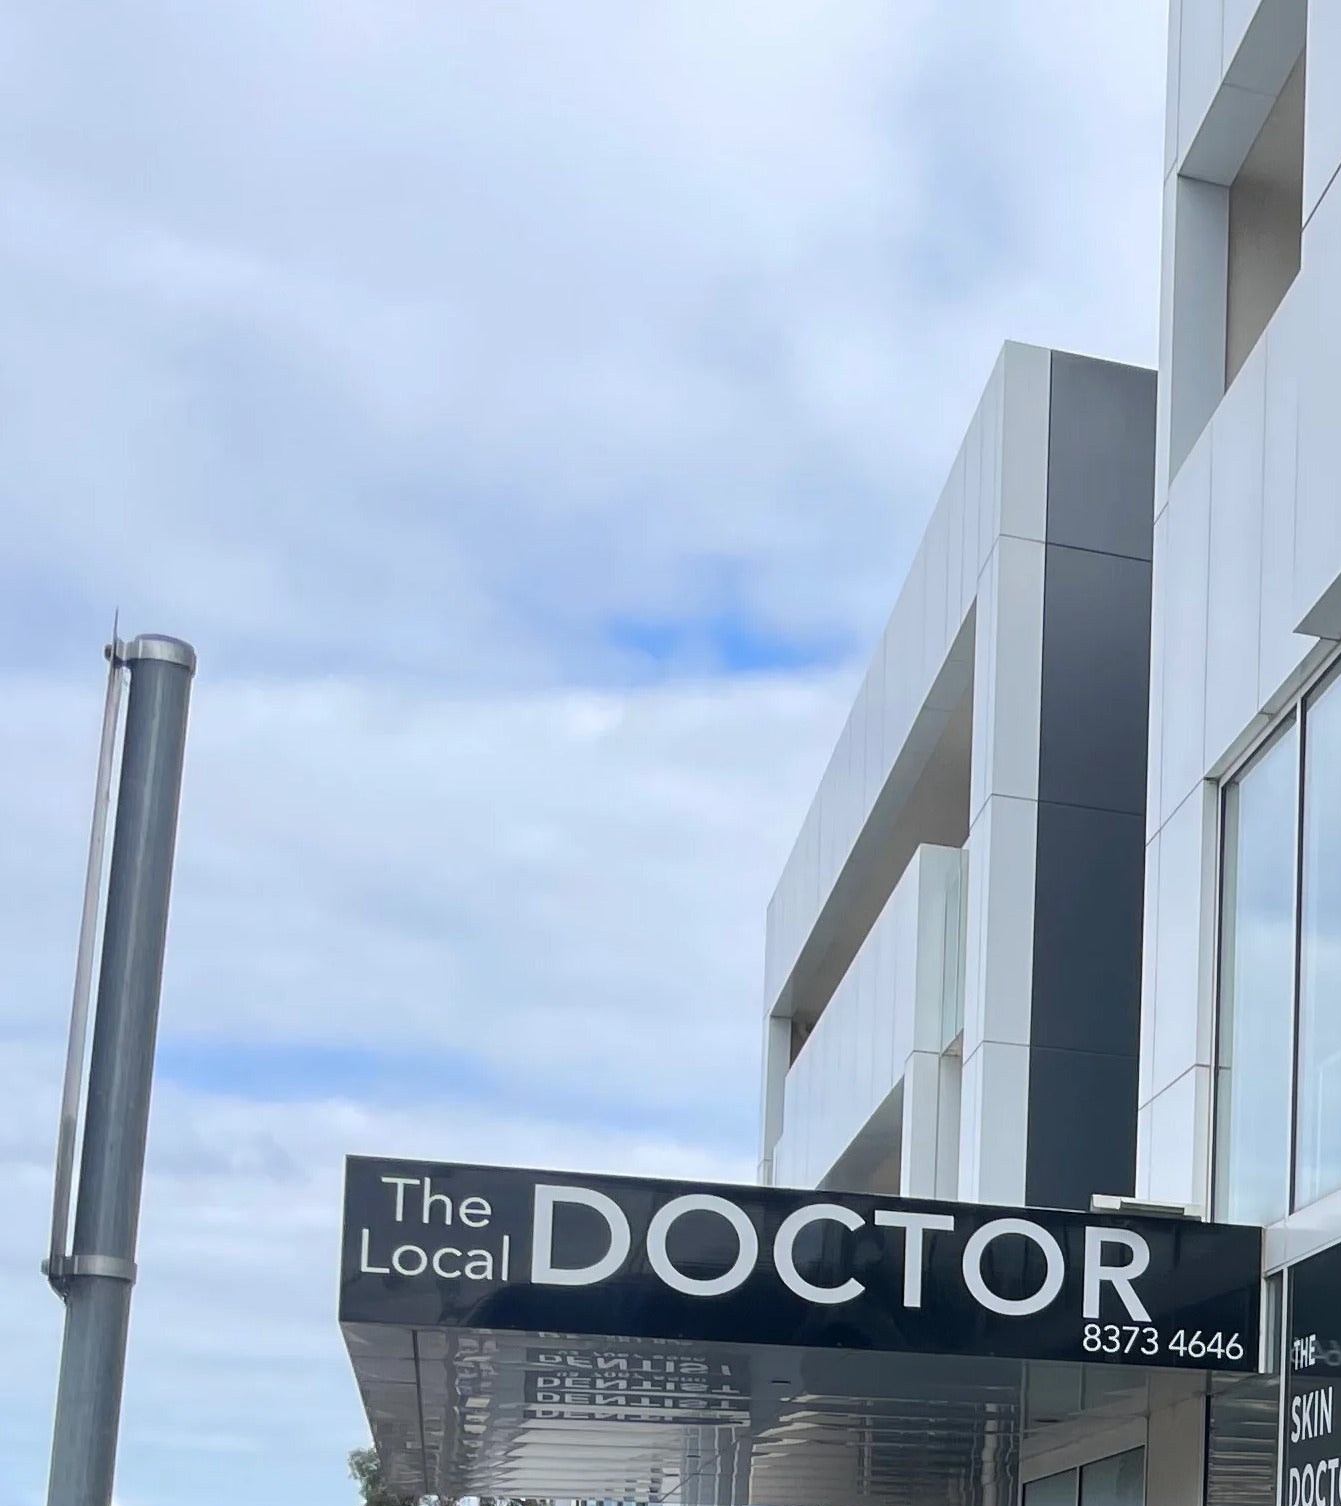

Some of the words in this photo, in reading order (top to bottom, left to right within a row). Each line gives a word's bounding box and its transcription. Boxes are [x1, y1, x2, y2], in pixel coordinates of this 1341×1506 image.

[381, 1176, 492, 1228] The
[360, 1228, 510, 1282] Local
[531, 1184, 1152, 1322] DOCTOR
[1083, 1324, 1159, 1356] 8373
[1169, 1330, 1244, 1360] 4646
[1294, 1334, 1317, 1371] THE
[1290, 1386, 1333, 1444] SKIN
